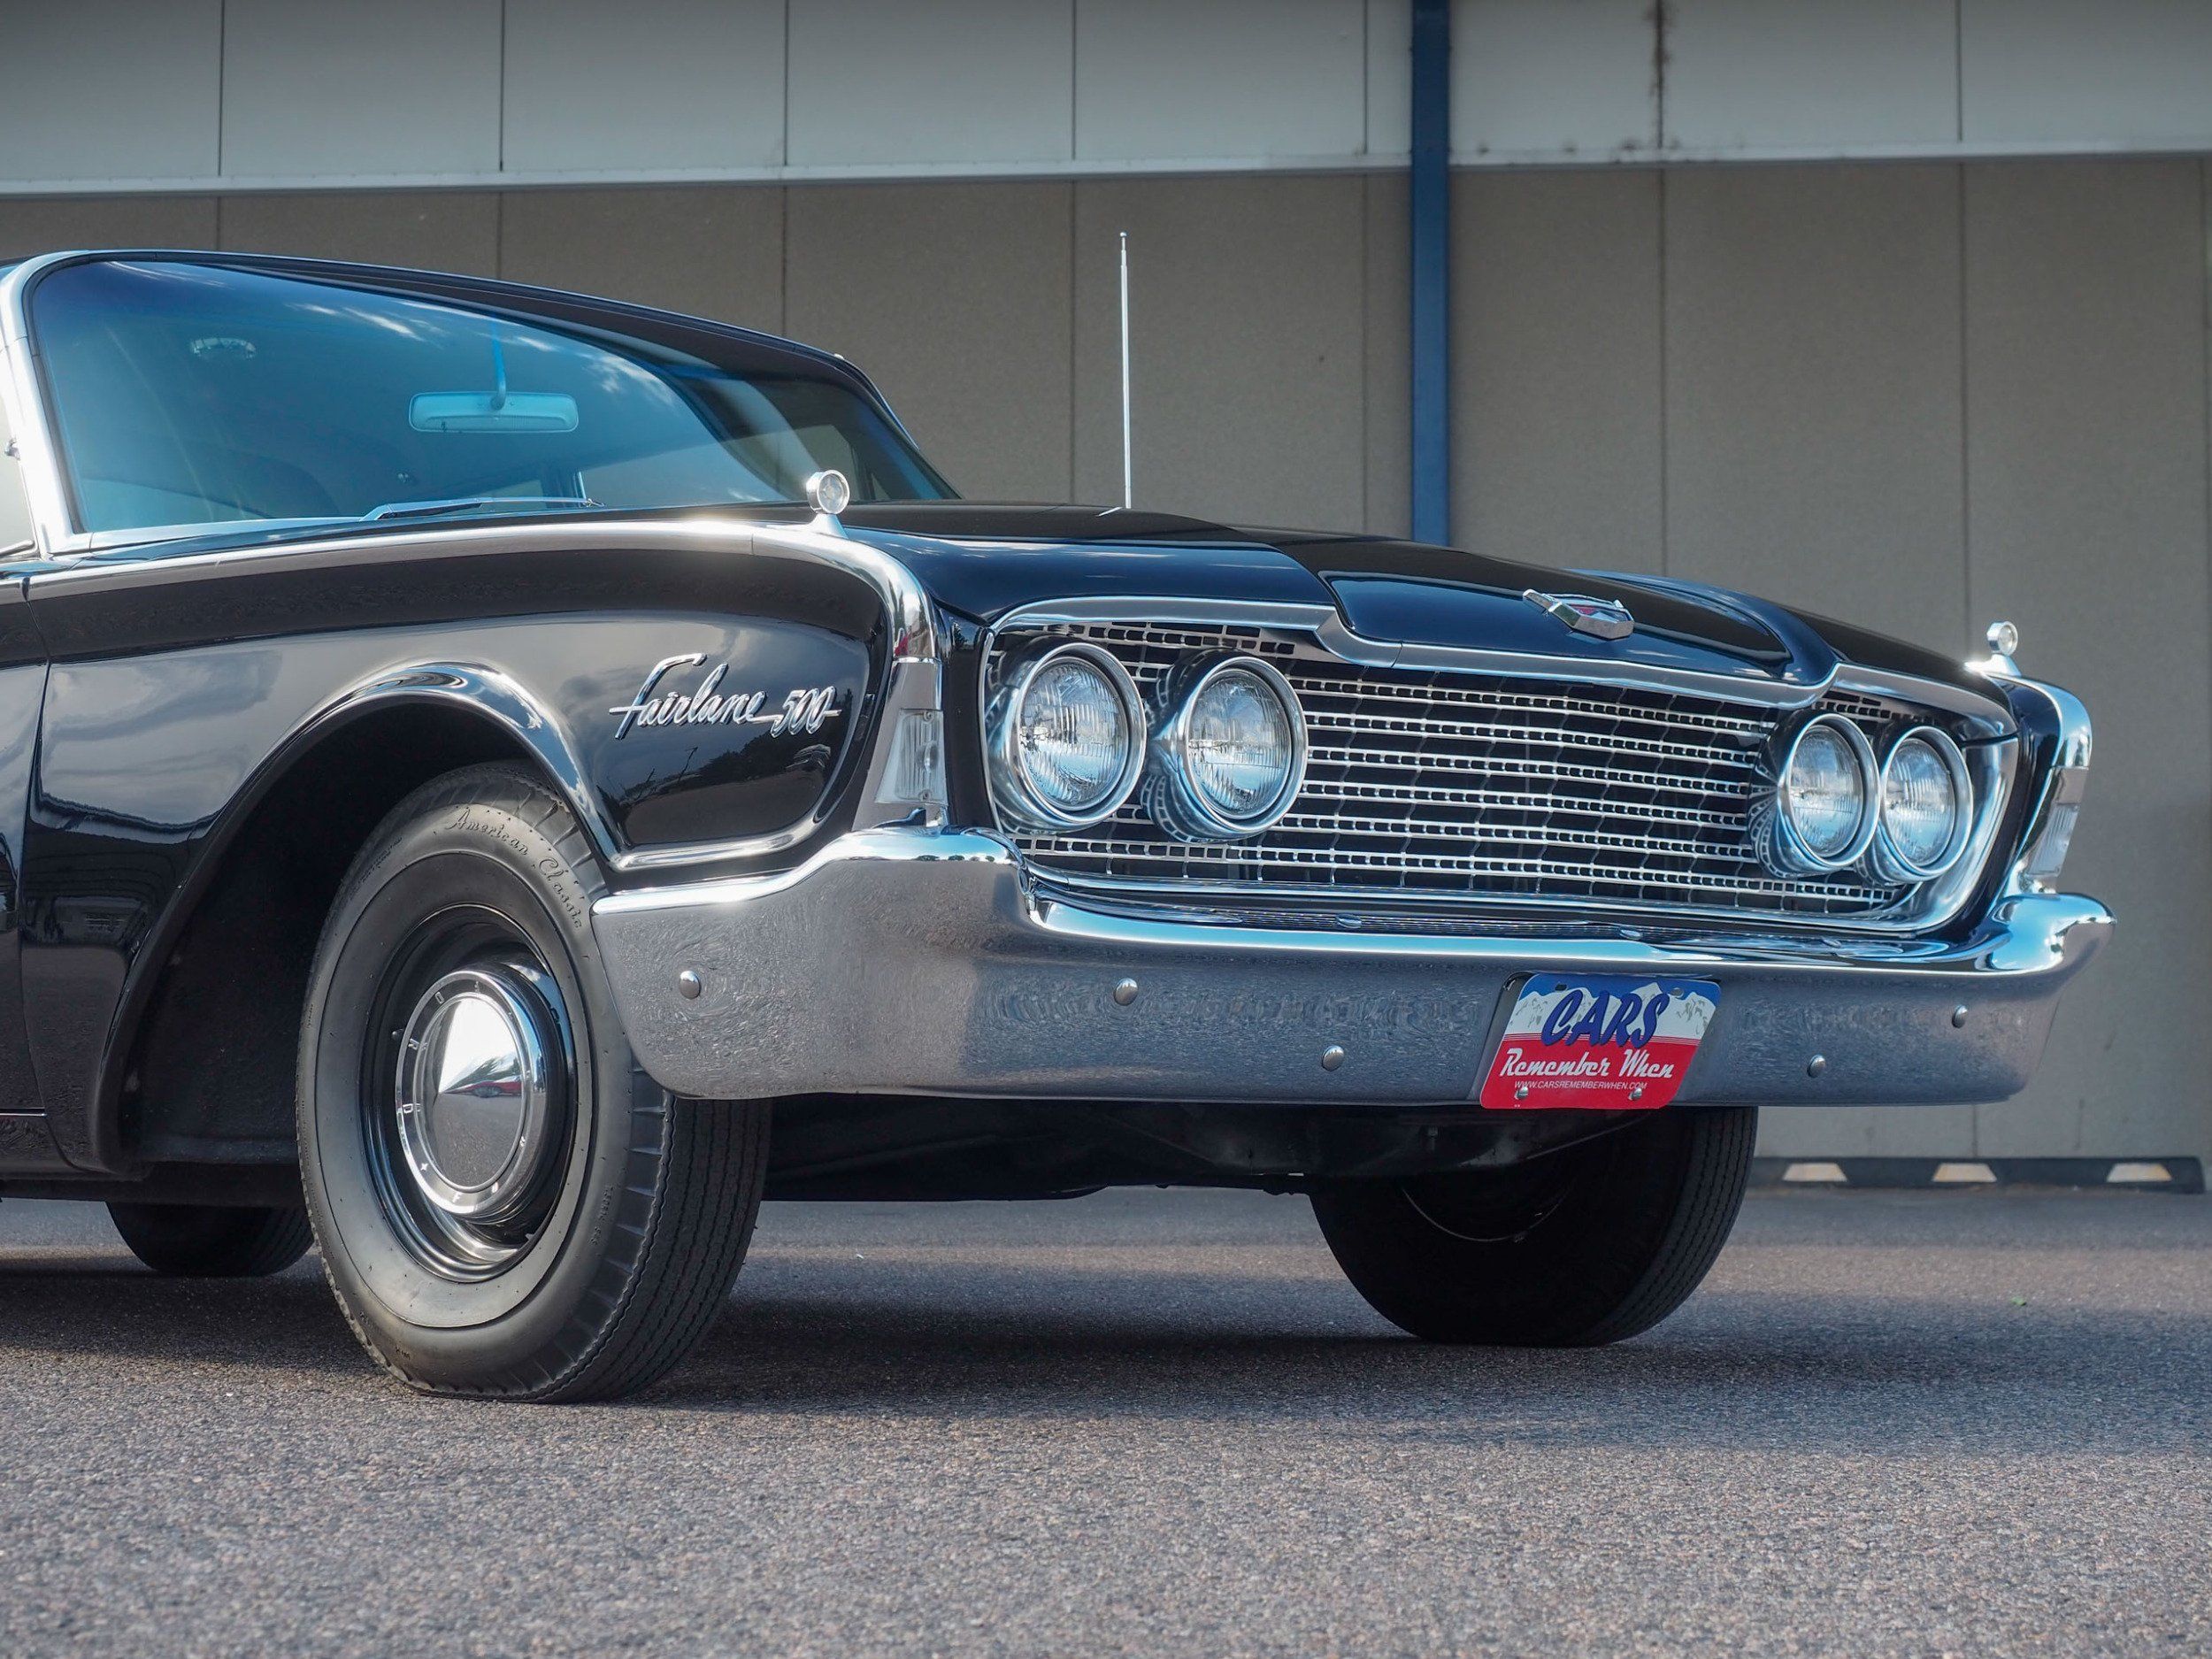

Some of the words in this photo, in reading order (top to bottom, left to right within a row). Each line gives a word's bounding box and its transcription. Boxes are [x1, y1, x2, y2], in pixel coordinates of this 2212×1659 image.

[609, 652, 769, 740] Fairlane
[771, 686, 841, 739] 500
[445, 808, 530, 856] American
[538, 857, 582, 929] Classic
[1540, 989, 1671, 1048] CARS
[1500, 1048, 1611, 1077] Remember
[1618, 1048, 1675, 1079] When
[1514, 1080, 1647, 1091] WWW.CARSREMEMBERWHEN.COM
